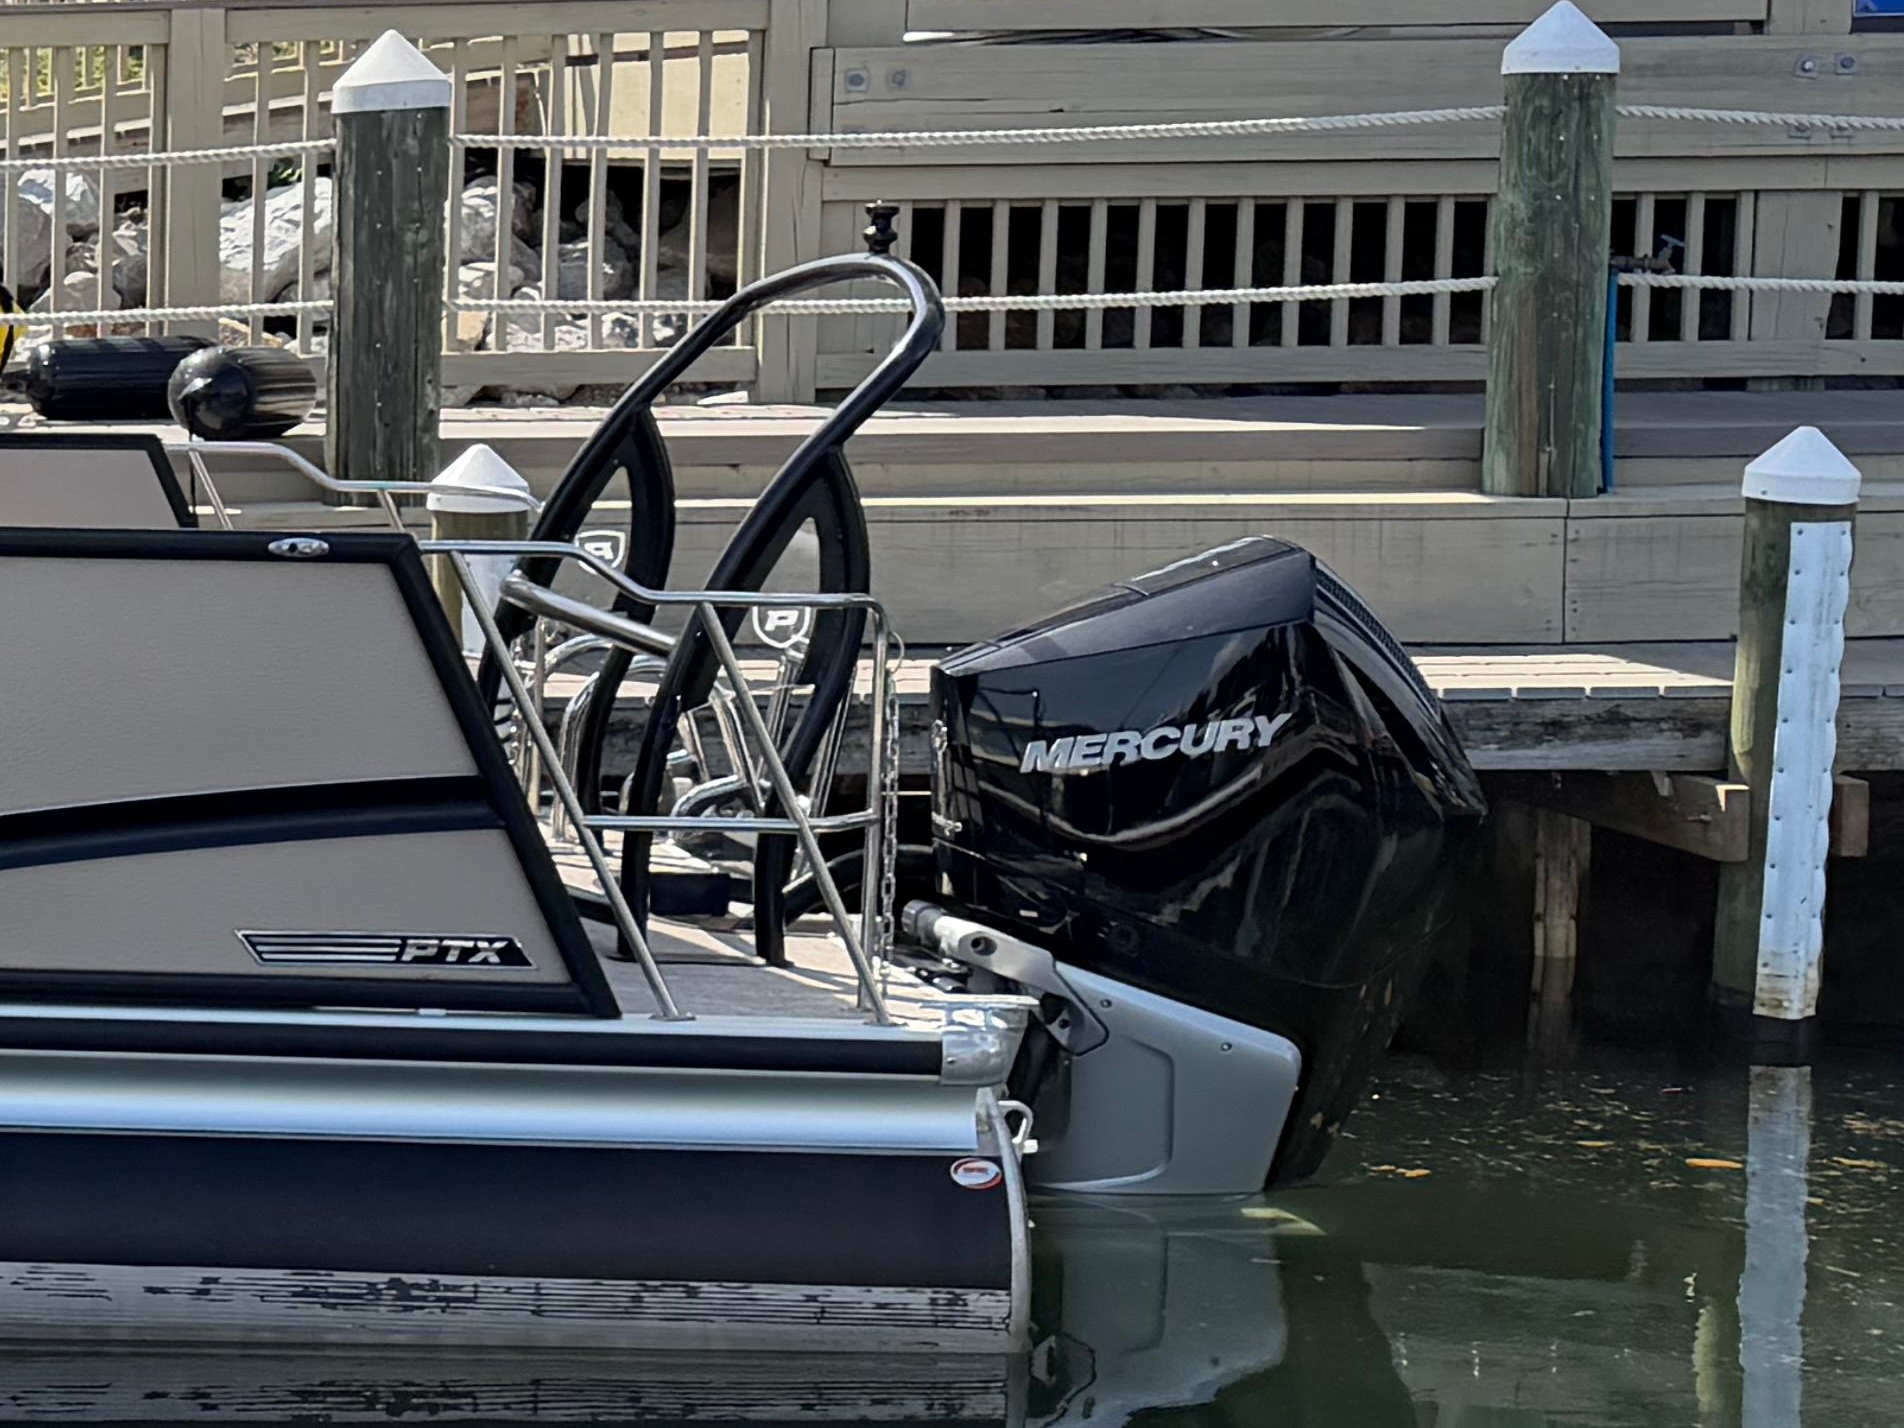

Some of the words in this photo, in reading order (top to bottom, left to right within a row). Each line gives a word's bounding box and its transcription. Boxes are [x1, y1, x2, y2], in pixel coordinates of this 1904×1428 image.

[764, 610, 800, 632] P
[1019, 712, 1293, 774] MERCURY
[400, 939, 509, 963] PTX
